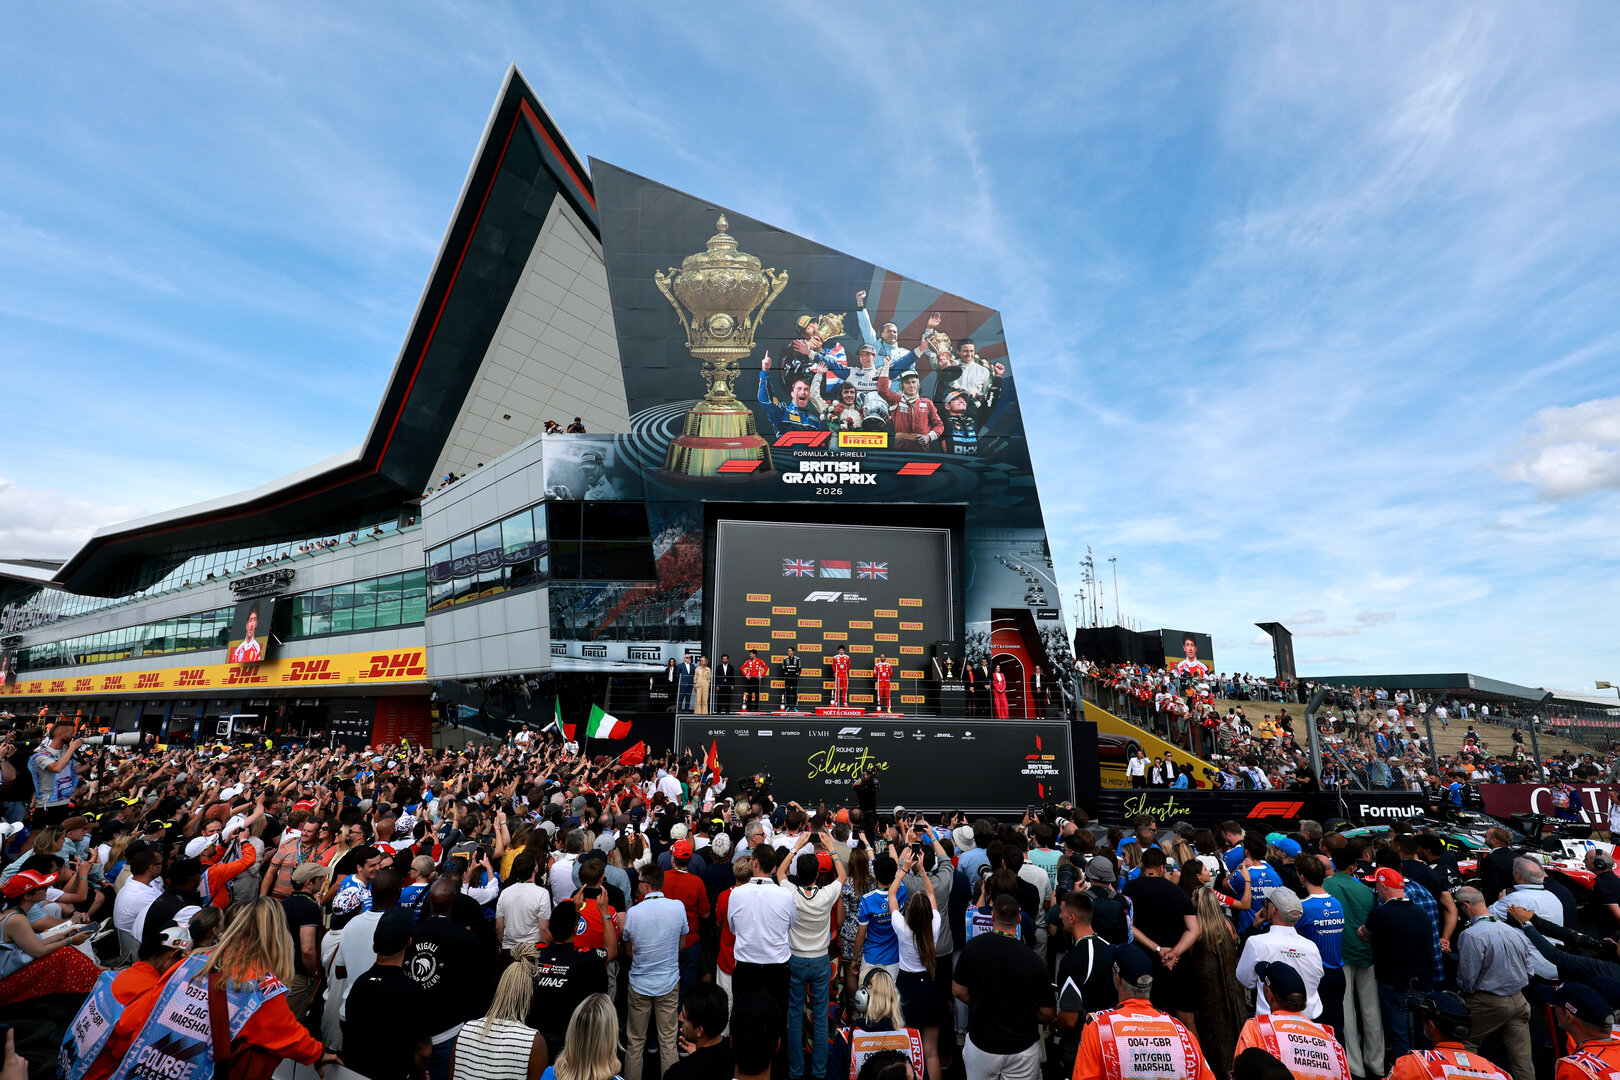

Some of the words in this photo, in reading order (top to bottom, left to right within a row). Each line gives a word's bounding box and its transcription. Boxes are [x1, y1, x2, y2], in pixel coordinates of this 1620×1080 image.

[842, 434, 884, 445] PIRELLI
[799, 461, 860, 473] BRITISH
[782, 472, 838, 484] GRAND
[839, 473, 877, 485] PRIX
[816, 487, 843, 495] 2026
[550, 643, 567, 655] RELLI
[582, 644, 607, 658] PIRELLI
[627, 646, 661, 661] PIRELLI
[75, 678, 92, 692] DHL
[103, 676, 123, 690] DHL
[137, 673, 160, 688] DHL
[178, 669, 206, 687] DHL
[227, 664, 262, 685] DHL
[289, 659, 332, 681] DHL
[368, 652, 425, 678] DHL
[1123, 792, 1191, 821] Silverstone
[1359, 804, 1425, 818] Formula
[1313, 918, 1345, 927] PETRONA
[415, 942, 438, 953] KIGALI
[538, 976, 568, 988] HAAS
[185, 986, 209, 1001] 0313-
[184, 1003, 209, 1020] FLAG
[168, 1011, 210, 1036] MARSHAL
[1127, 1037, 1172, 1047] 0047-GBR
[1287, 1033, 1327, 1048] 0054-GBR
[910, 1036, 922, 1072] BRIT
[1133, 1053, 1172, 1062] PIT/GRID
[1294, 1048, 1329, 1061] PIT/GRID
[136, 1044, 199, 1080] COURSE
[1133, 1063, 1175, 1072] MARSHAL
[1293, 1057, 1331, 1071] MARSHAL
[134, 1065, 172, 1080] ACCE
